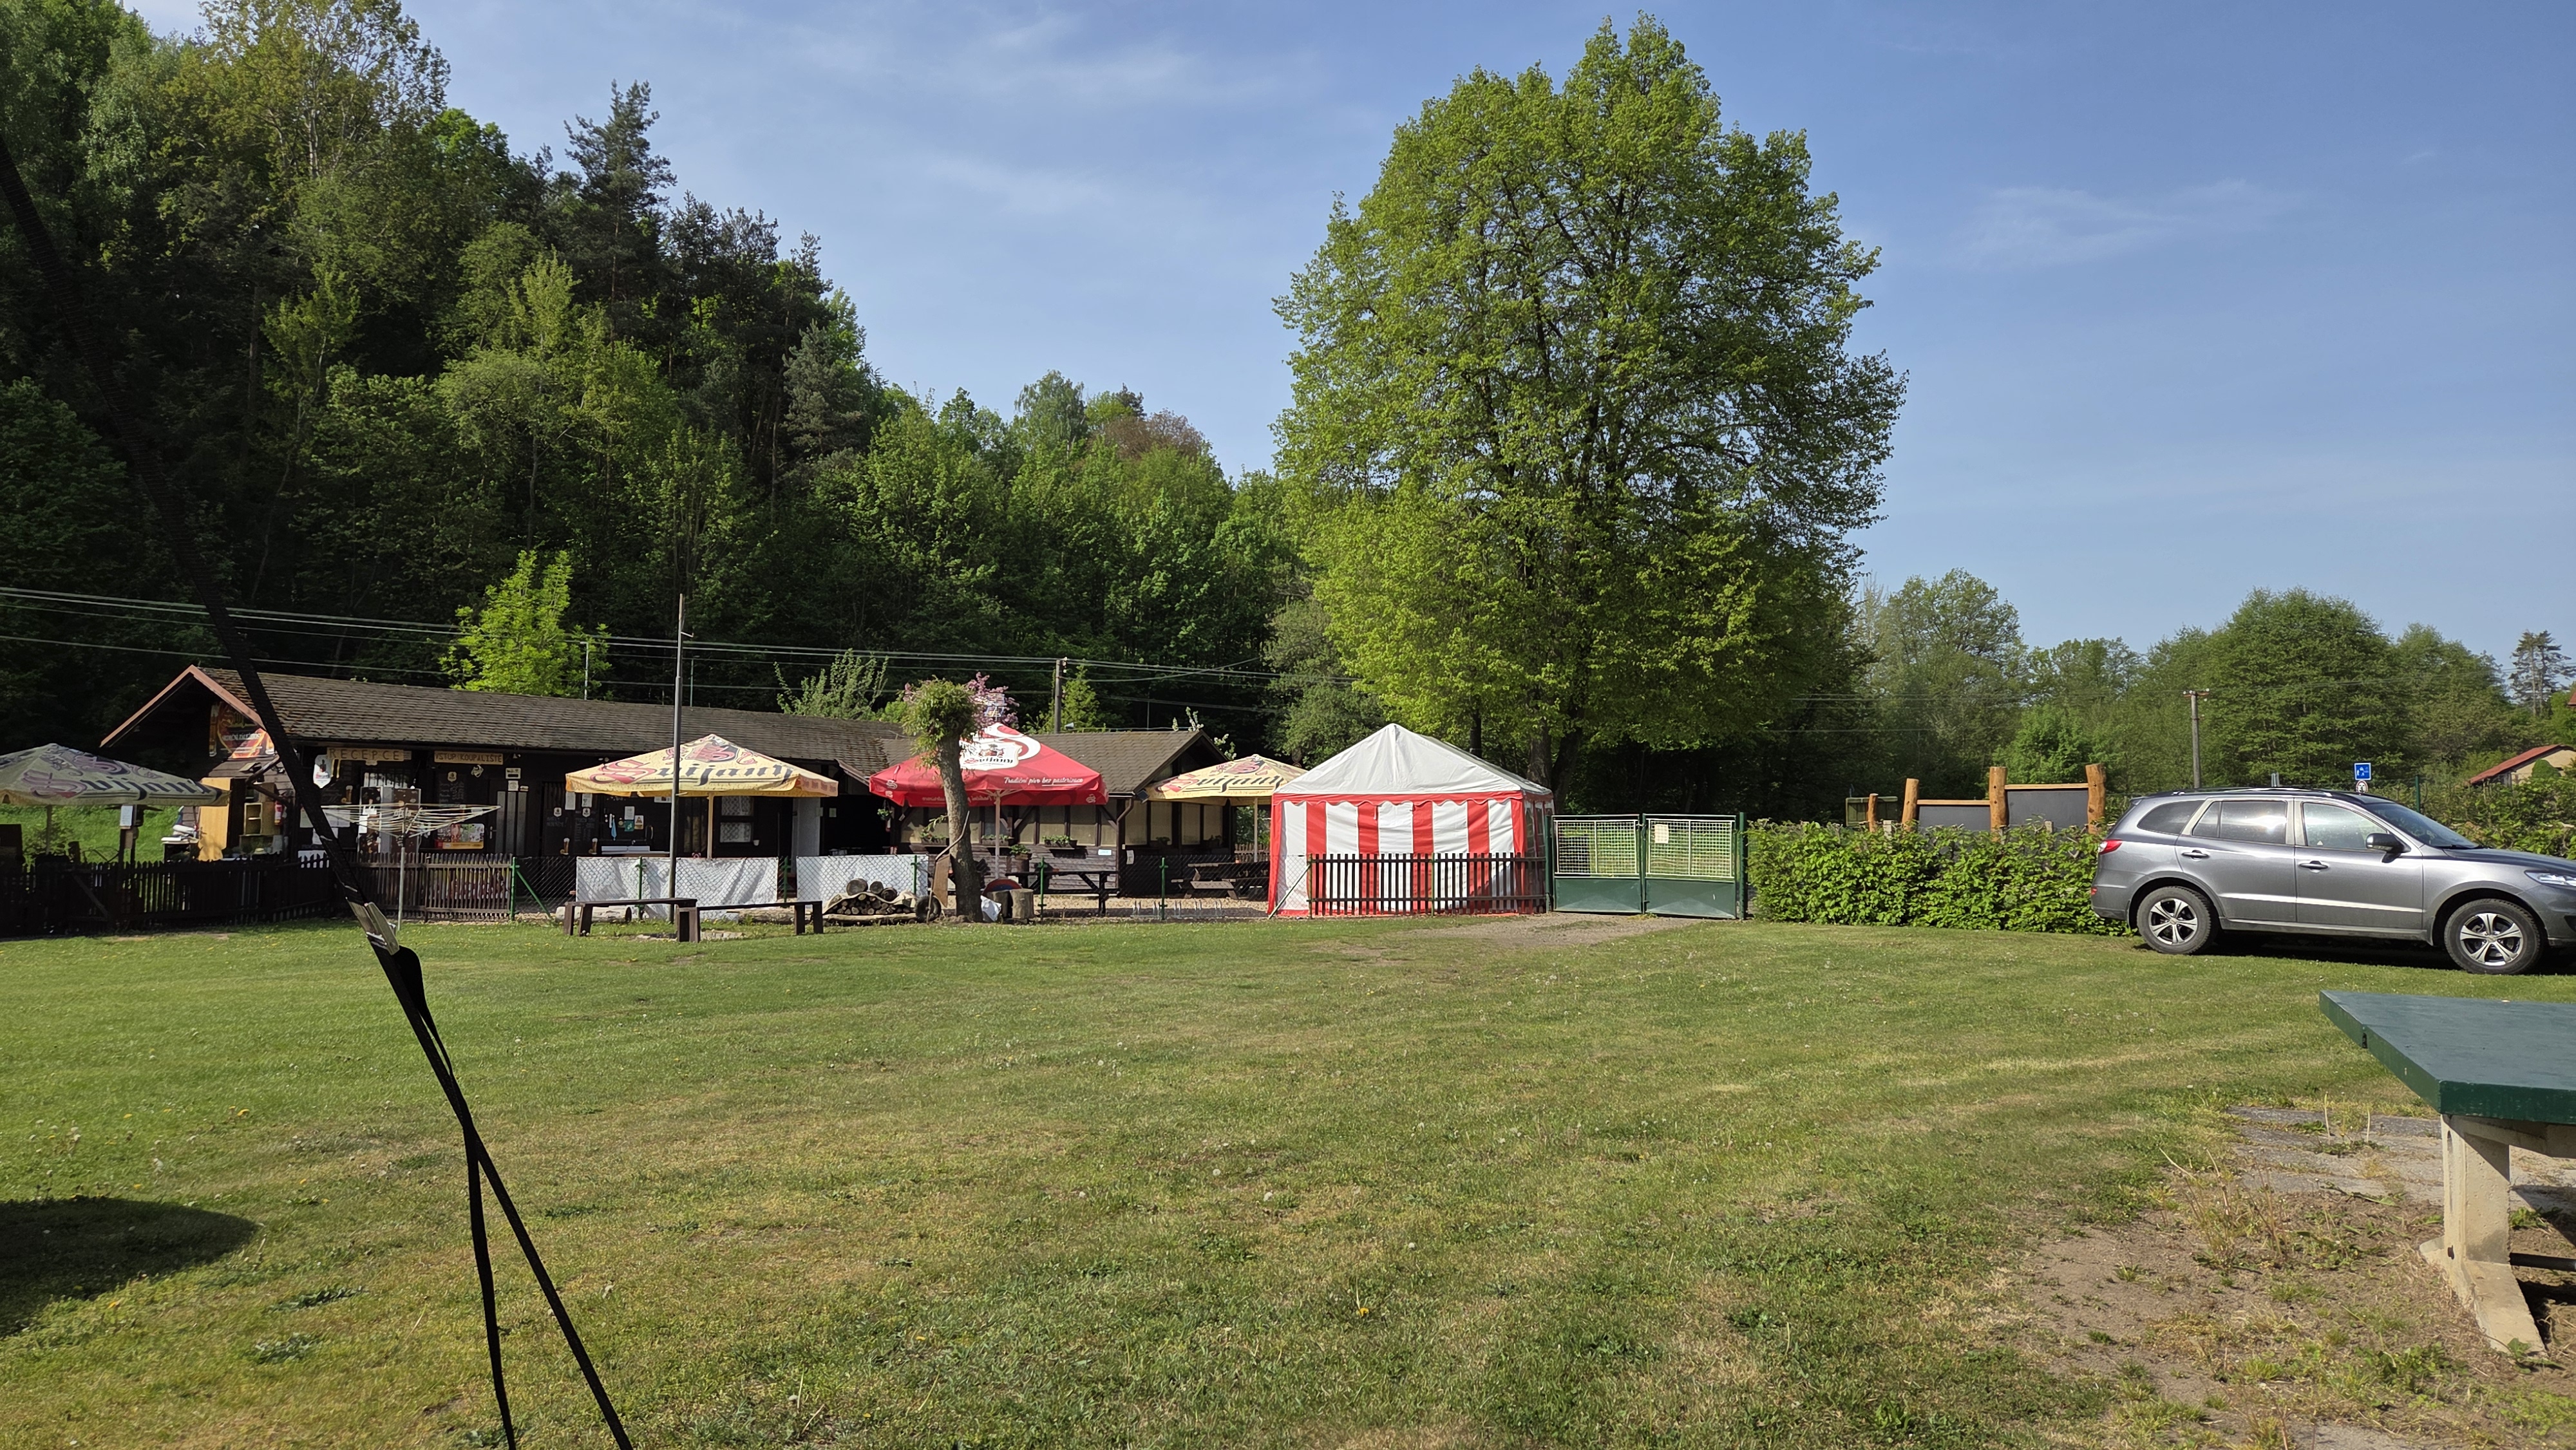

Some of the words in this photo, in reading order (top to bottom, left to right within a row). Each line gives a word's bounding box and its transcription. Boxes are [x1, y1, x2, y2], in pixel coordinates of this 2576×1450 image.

[329, 748, 399, 760] RECEPCE
[589, 760, 793, 786] Svijany
[1052, 777, 1083, 785] pasterizace
[1155, 773, 1284, 793] Svijany
[21, 769, 223, 800] Svijany
